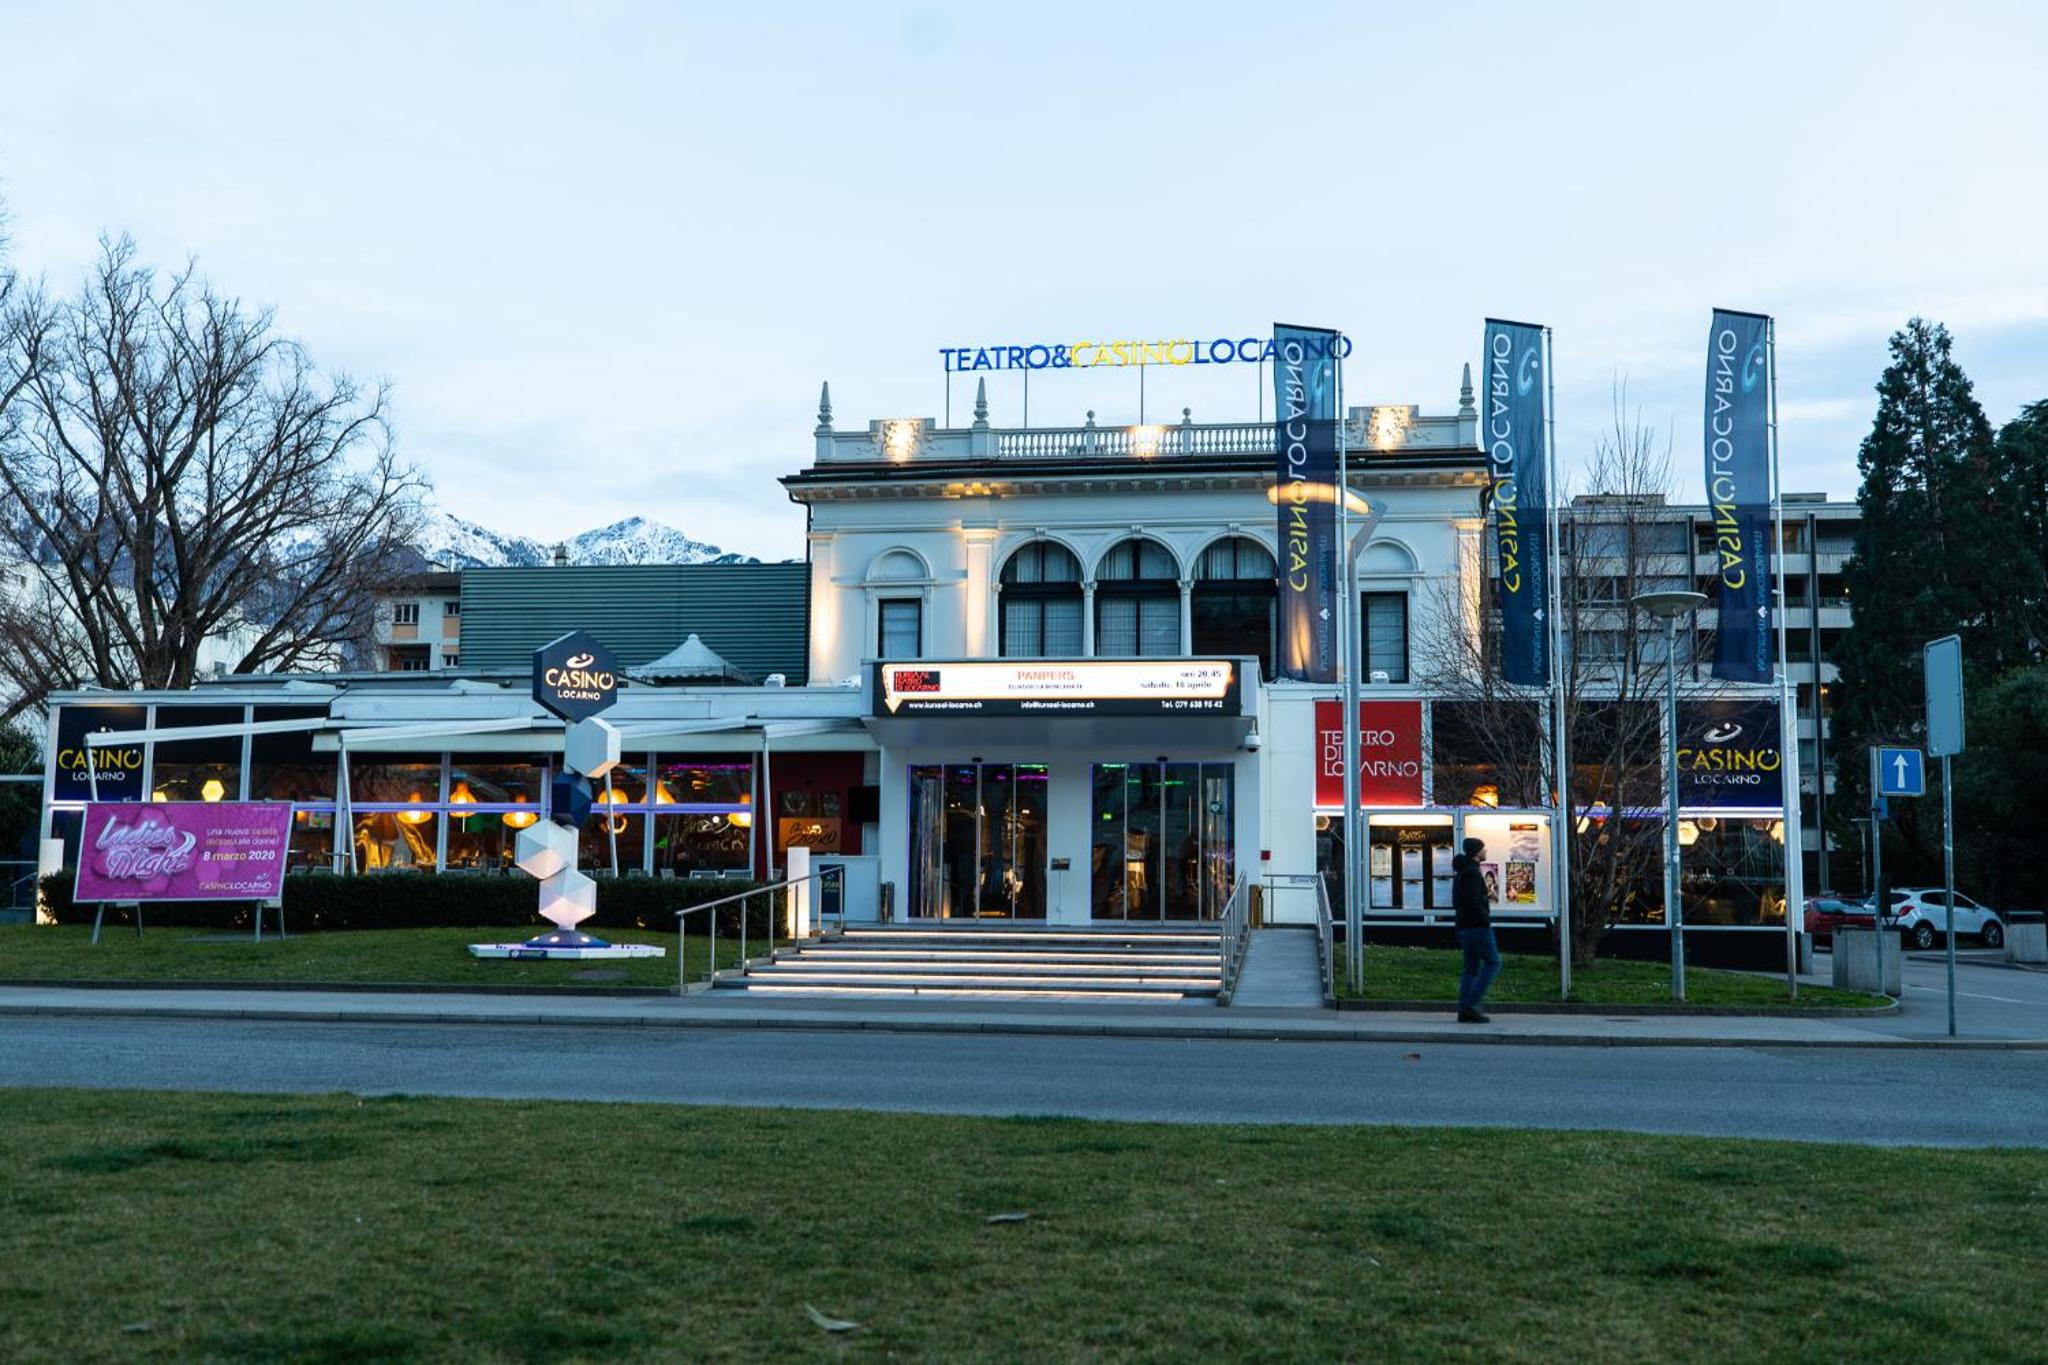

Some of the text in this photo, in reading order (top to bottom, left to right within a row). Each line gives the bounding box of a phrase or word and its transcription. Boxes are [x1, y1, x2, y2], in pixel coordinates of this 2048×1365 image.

[545, 668, 614, 690] CASINO
[557, 689, 600, 701] LOCARNO
[1320, 730, 1395, 746] TETRO
[1324, 745, 1342, 761] DI
[1676, 749, 1780, 771] CASINO
[1324, 760, 1418, 777] LOARNO
[1694, 774, 1761, 785] LOCARNO
[96, 815, 176, 850] Ladies
[106, 847, 188, 878] Night
[202, 850, 276, 861] 8 marzo 2020
